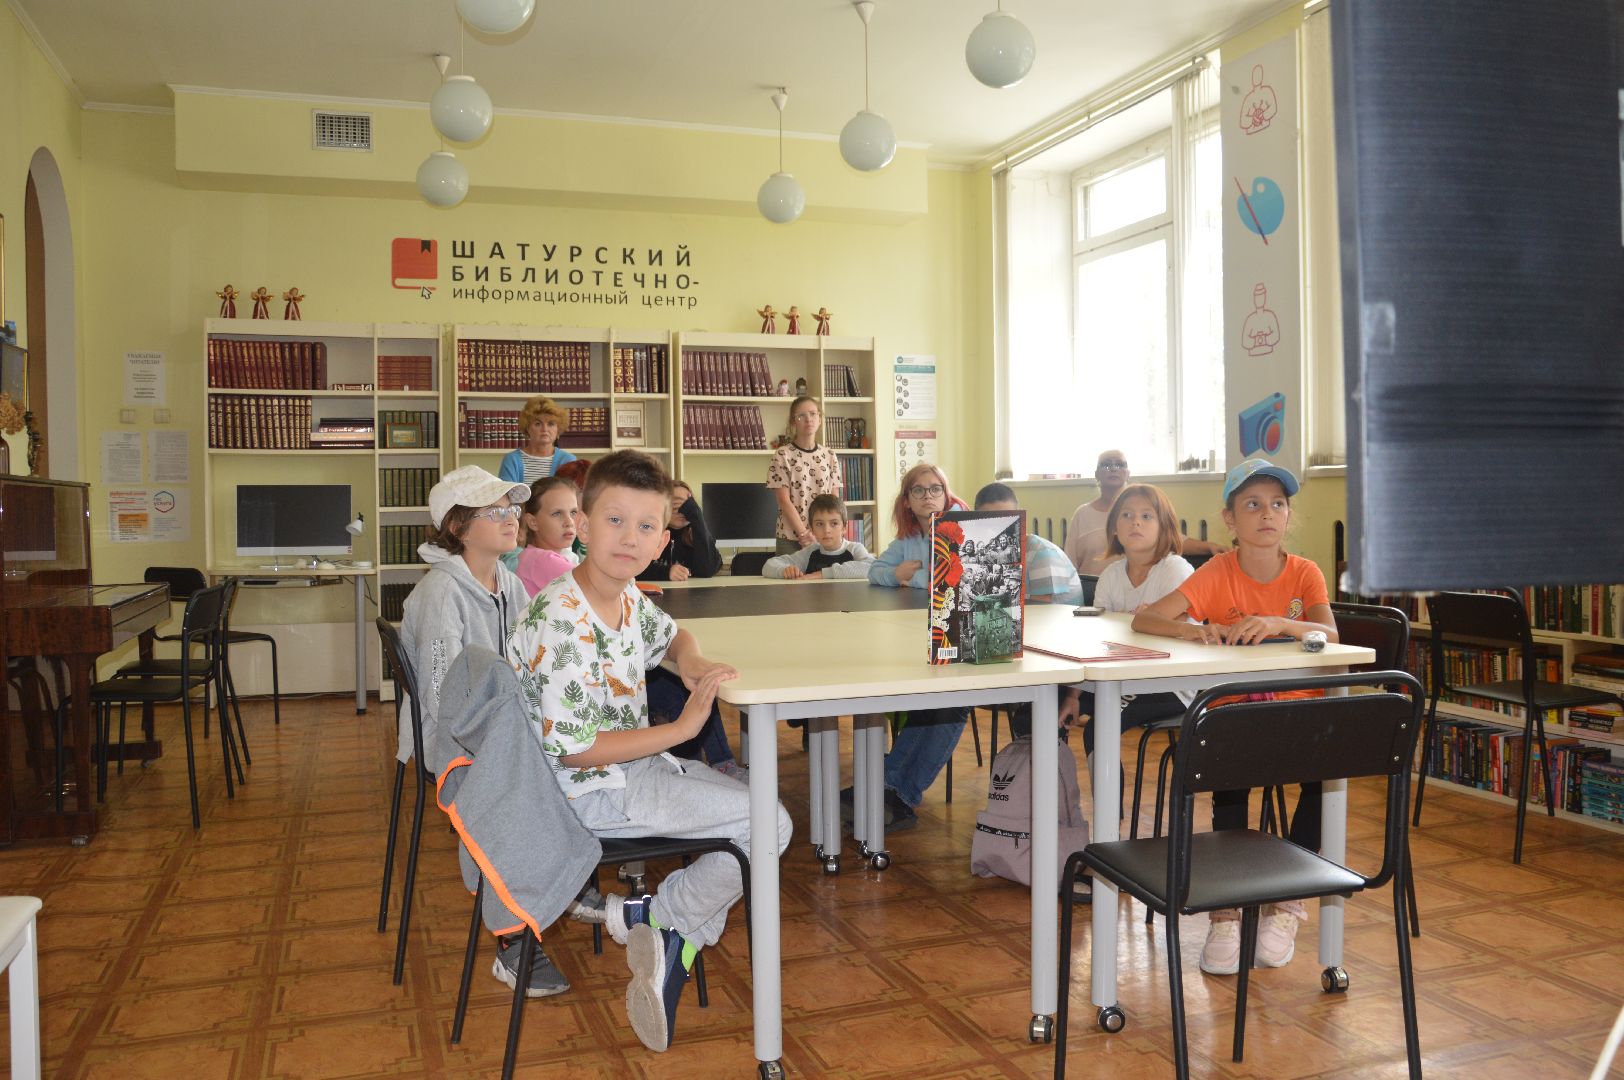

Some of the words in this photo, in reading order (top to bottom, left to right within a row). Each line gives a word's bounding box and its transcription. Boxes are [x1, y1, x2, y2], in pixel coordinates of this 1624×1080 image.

[452, 240, 691, 266] ШАТУРСКИЙ
[452, 266, 700, 290] БИБЛИОТЕЧНО-
[452, 285, 629, 305] информационный
[641, 293, 698, 309] центр
